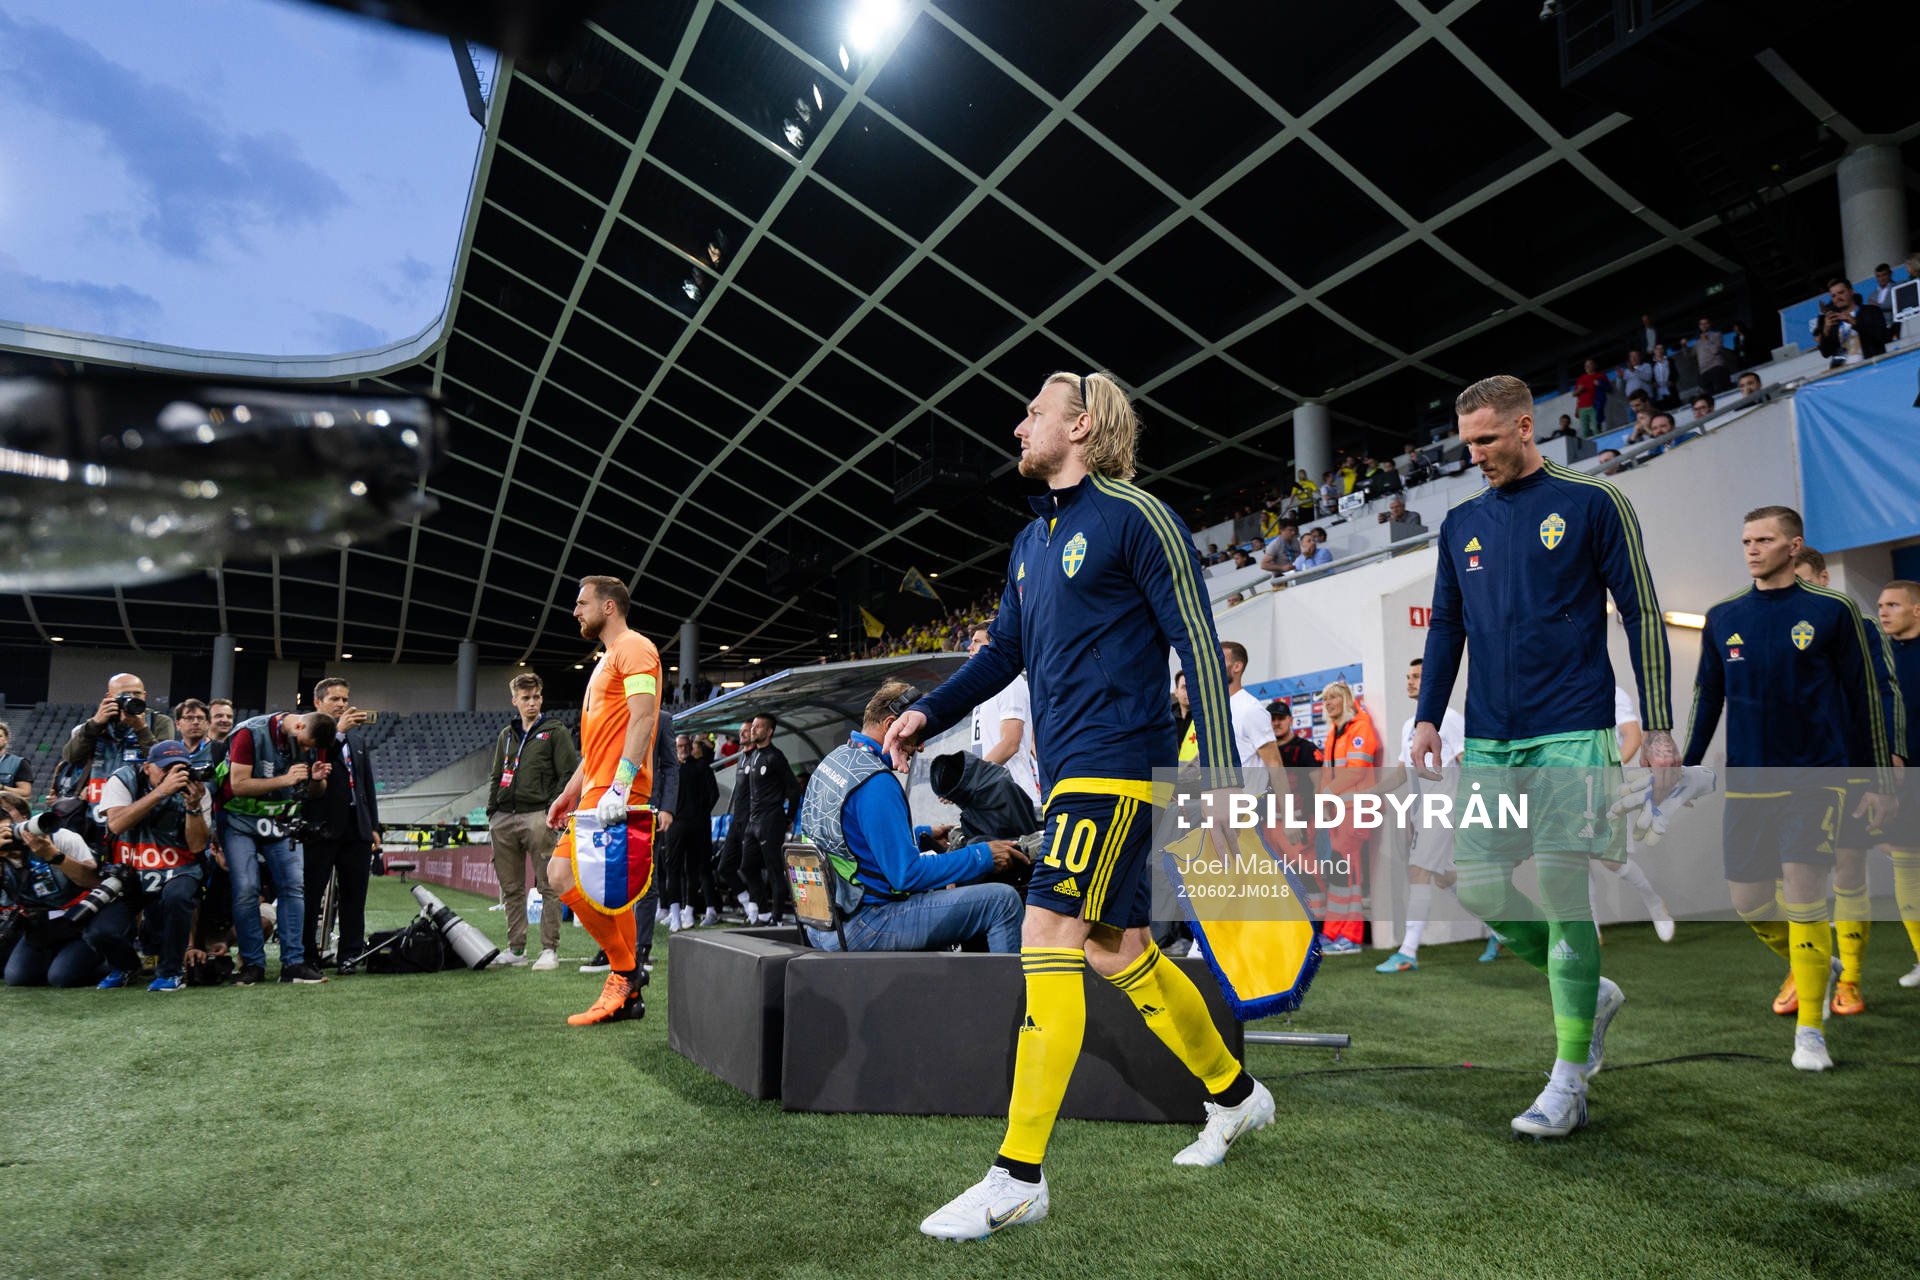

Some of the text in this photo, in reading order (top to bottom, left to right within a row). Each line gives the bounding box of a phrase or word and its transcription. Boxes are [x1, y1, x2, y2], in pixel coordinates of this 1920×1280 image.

[1583, 774, 1596, 819] 1
[1043, 812, 1097, 873] 10
[1053, 885, 1081, 898] adidas
